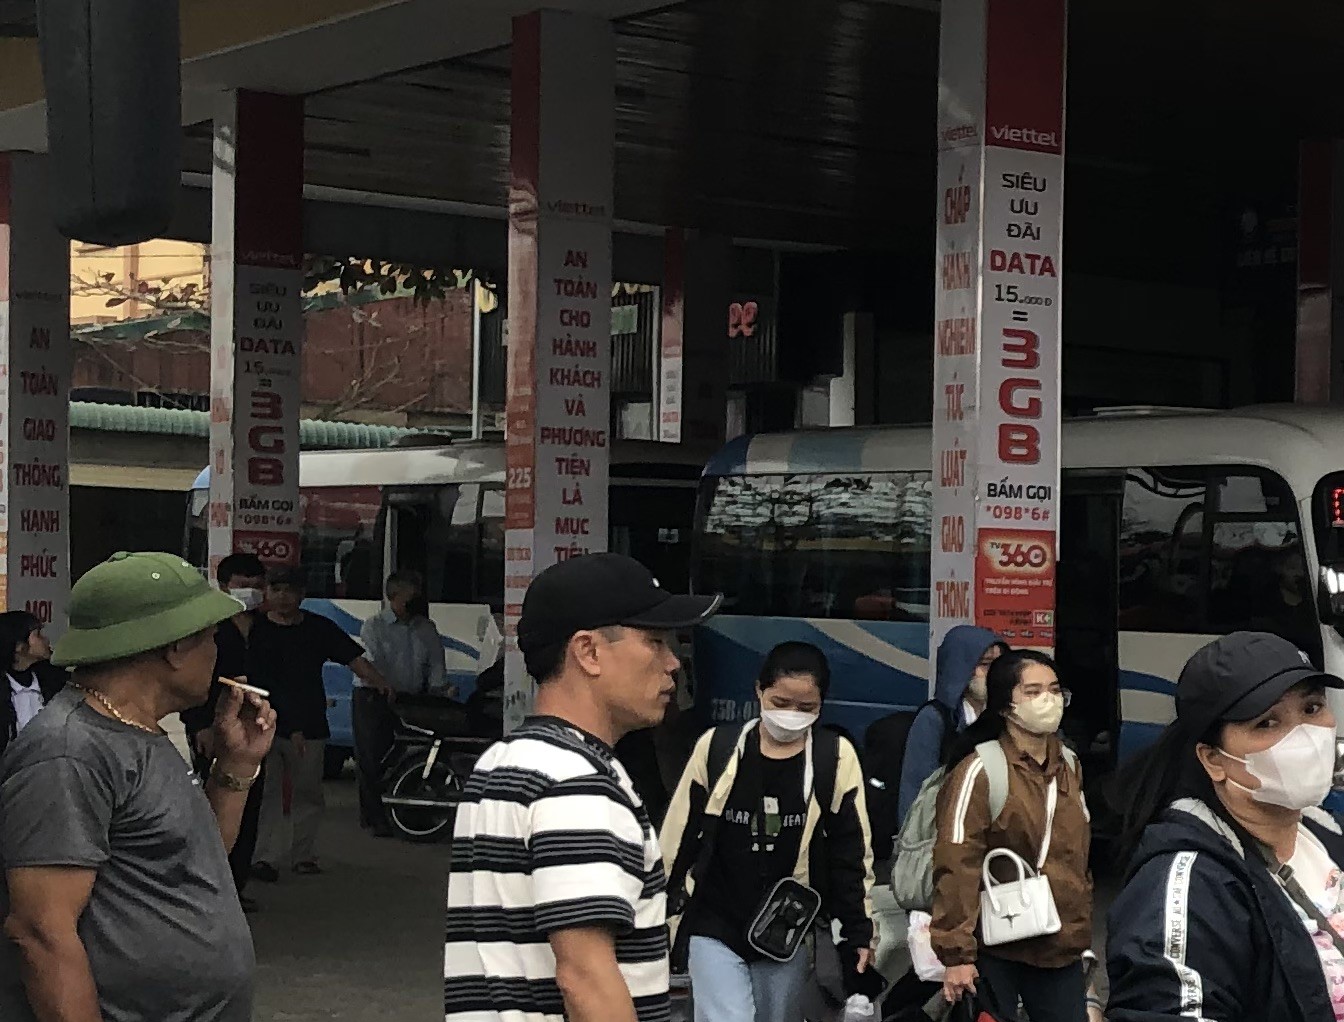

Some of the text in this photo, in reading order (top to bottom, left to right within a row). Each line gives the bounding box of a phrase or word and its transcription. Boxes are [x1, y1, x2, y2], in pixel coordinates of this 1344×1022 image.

[990, 125, 1058, 148] viettel
[1001, 172, 1047, 193] SIÊU
[1009, 198, 1039, 216] ƯU
[1006, 222, 1041, 240] ĐÃI
[563, 249, 588, 269] AN
[989, 249, 1057, 278] DATA
[553, 272, 599, 299] TOÀN
[559, 309, 591, 327] CHO
[29, 328, 51, 350] AN
[240, 337, 297, 356] DATA
[552, 334, 598, 358] HÀNH
[1000, 328, 1041, 370] 3
[549, 364, 602, 389] KHÁCH
[250, 391, 284, 420] 3
[564, 394, 587, 417] VÀ
[997, 377, 1043, 420] G
[23, 417, 56, 442] GIAO
[248, 426, 285, 455] G
[997, 422, 1041, 465] B
[247, 457, 284, 486] B
[986, 476, 1052, 504] BẤM GỌI
[941, 515, 965, 553] GIAO
[20, 549, 58, 578] PHÚC
